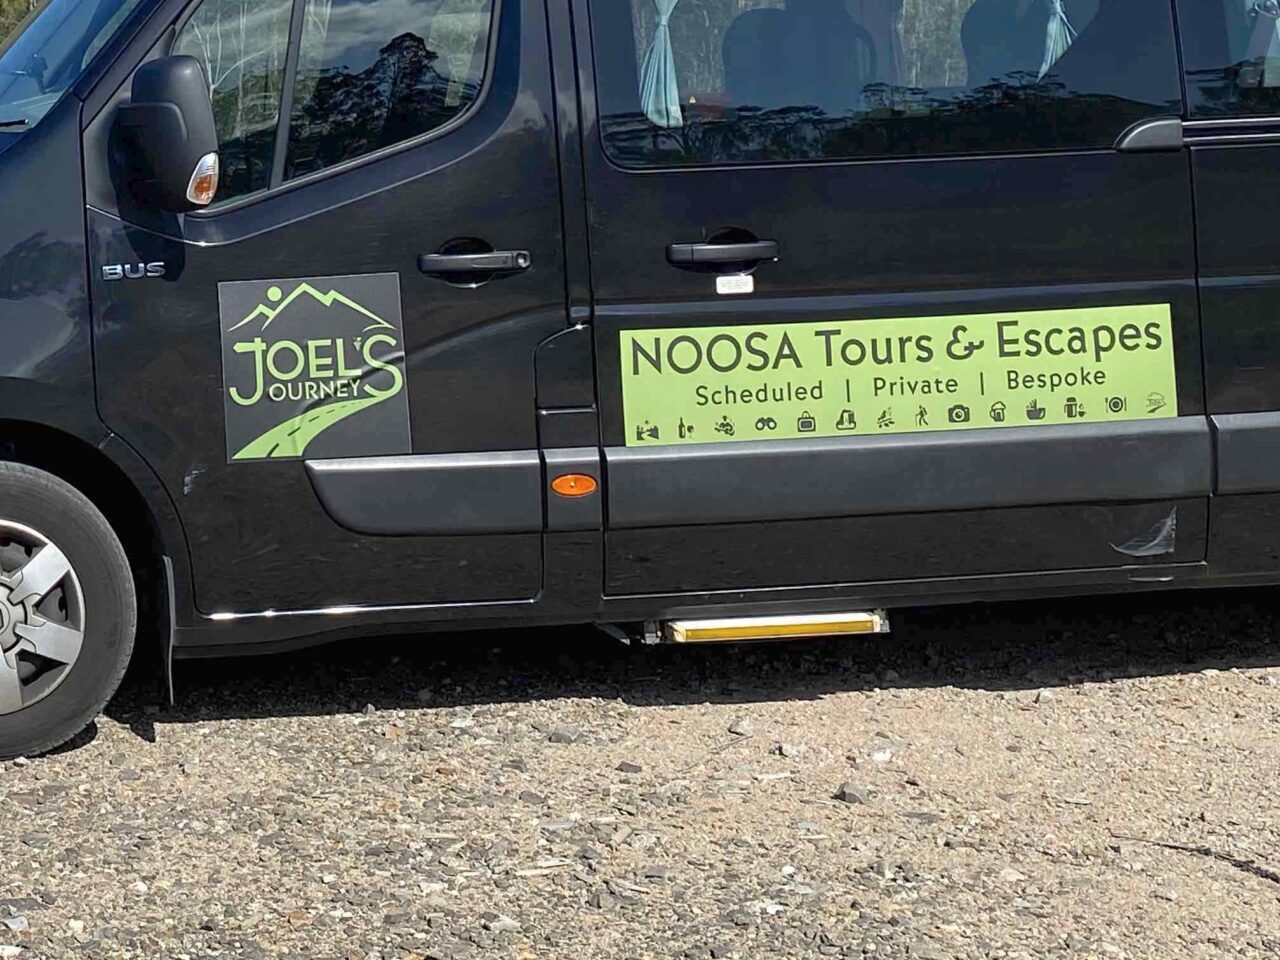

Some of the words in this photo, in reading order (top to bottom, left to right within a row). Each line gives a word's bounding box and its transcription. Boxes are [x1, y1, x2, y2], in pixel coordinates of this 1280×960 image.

[102, 262, 166, 281] BUS
[631, 330, 803, 376] NOOSA
[814, 329, 934, 367] Tours
[946, 324, 985, 361] &
[996, 320, 1162, 363] Escapes
[695, 379, 824, 407] Scheduled
[873, 376, 959, 397] Private
[1006, 367, 1107, 392] Bespoke
